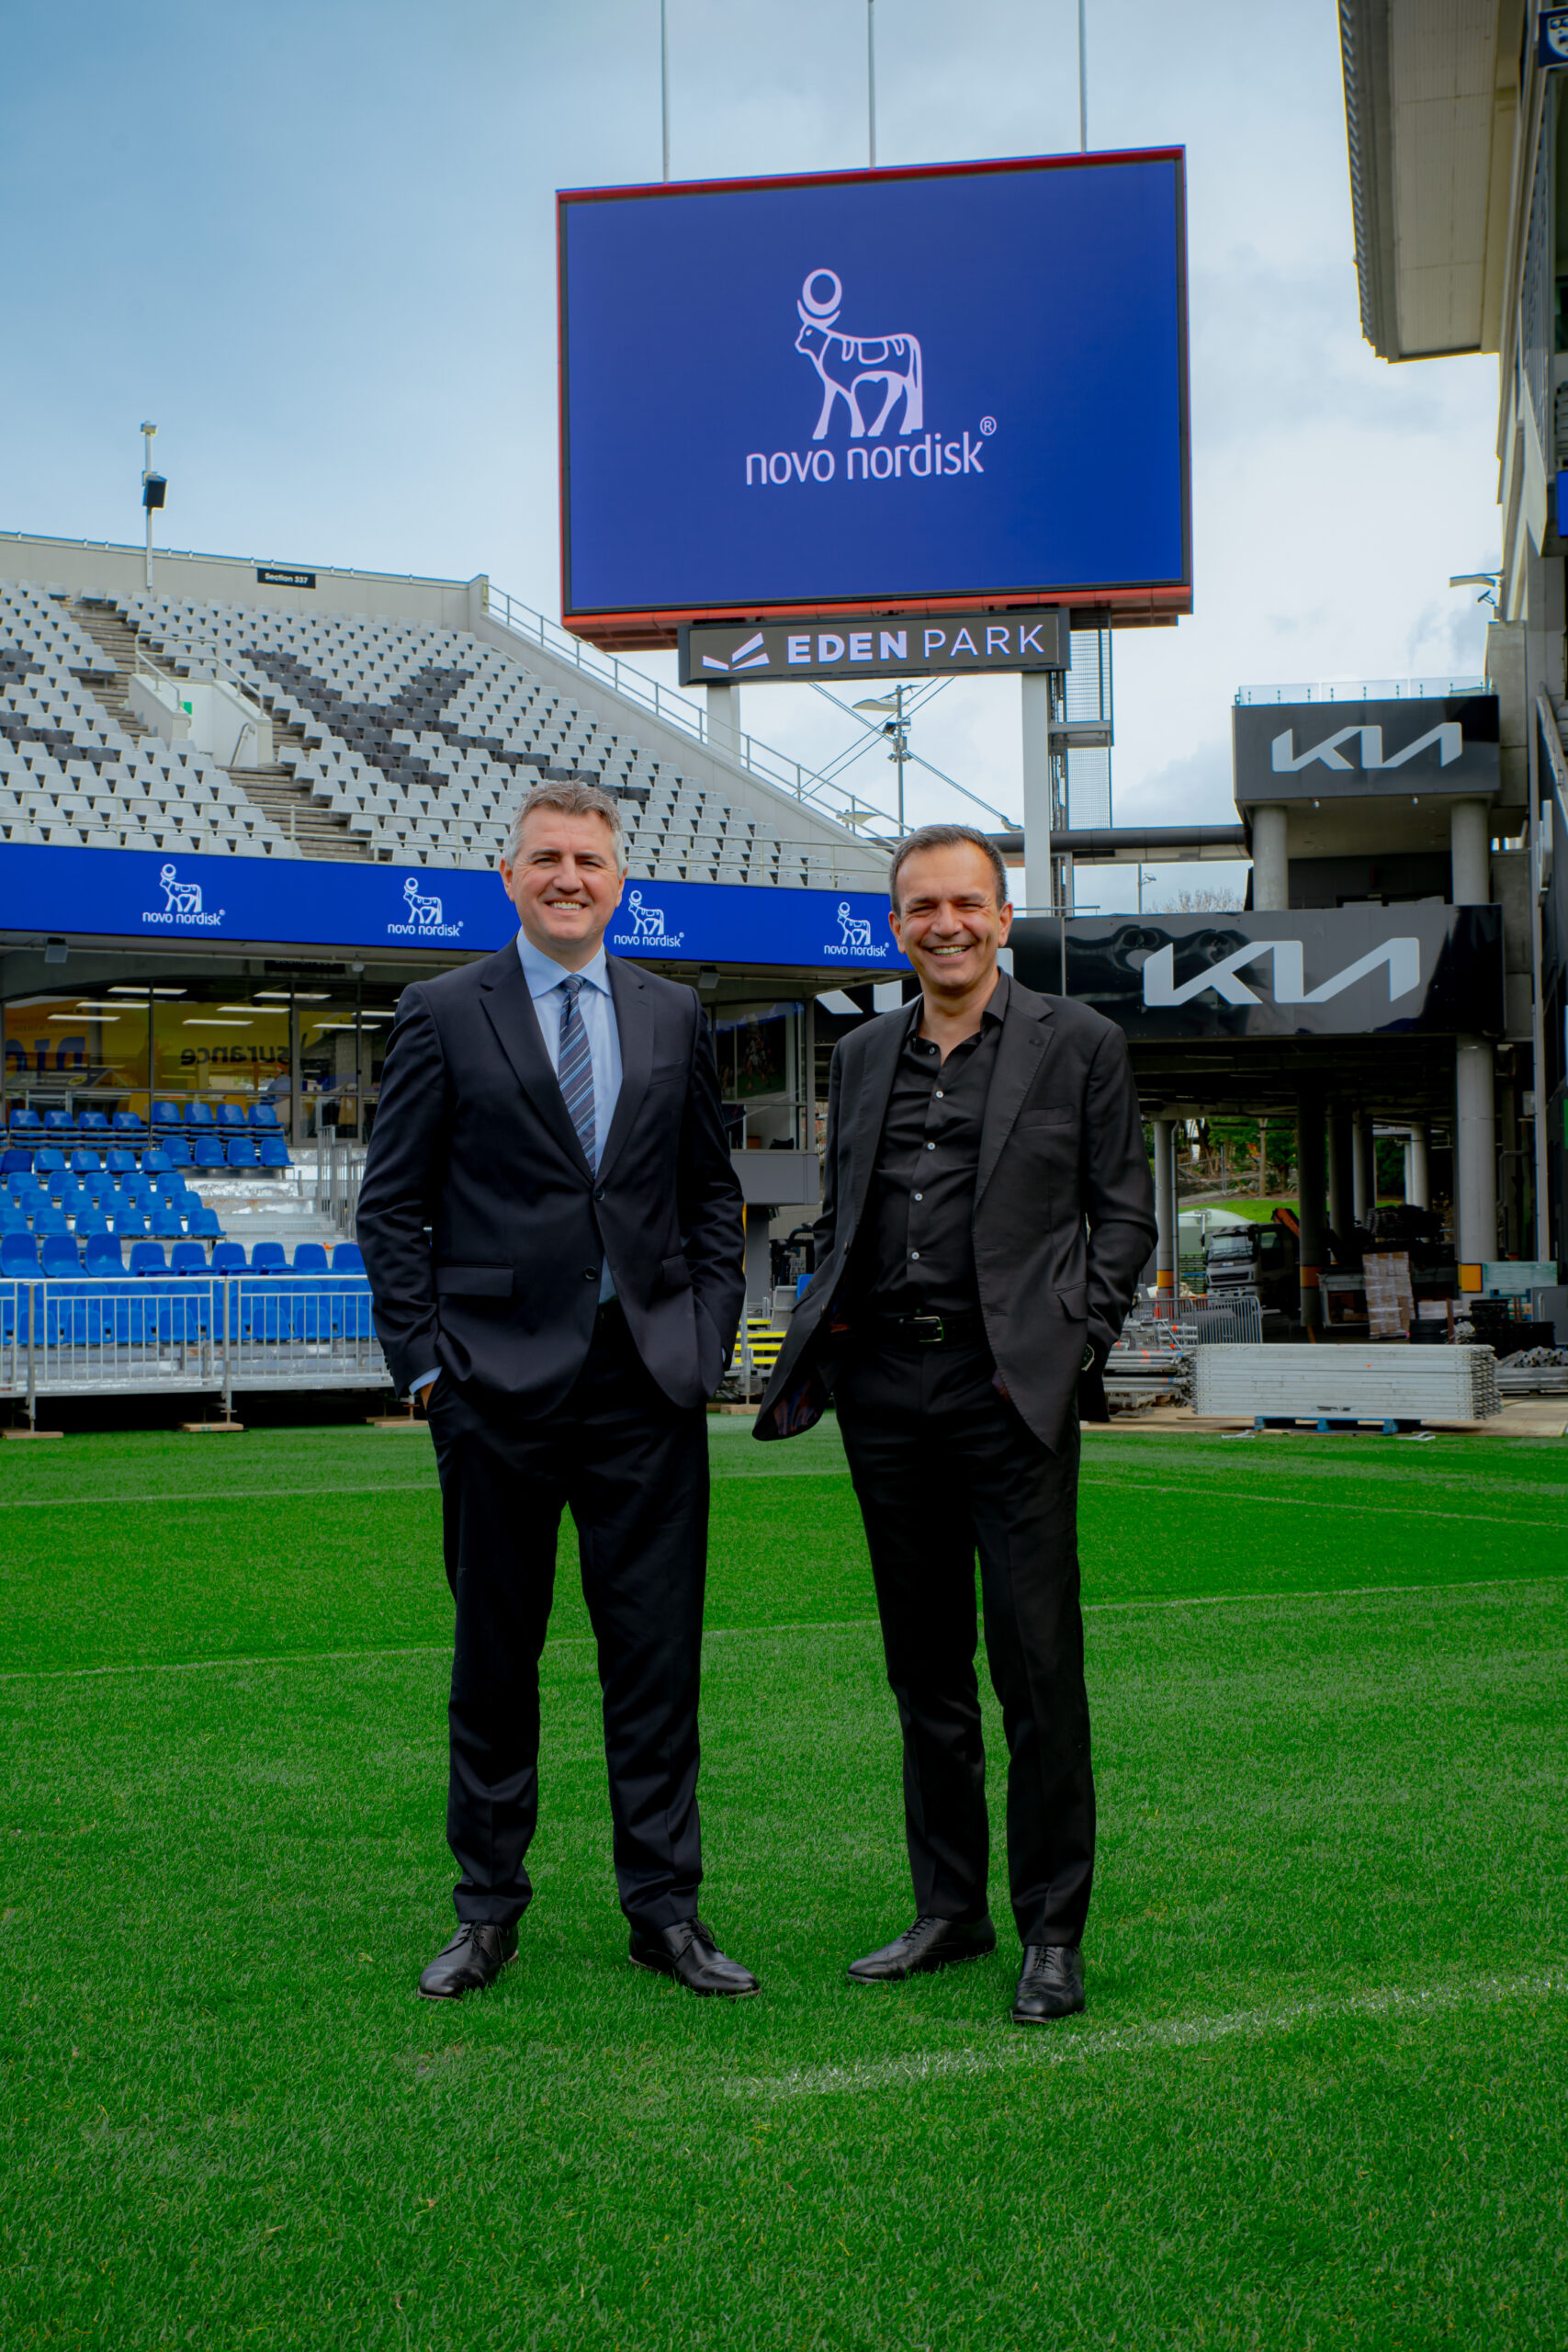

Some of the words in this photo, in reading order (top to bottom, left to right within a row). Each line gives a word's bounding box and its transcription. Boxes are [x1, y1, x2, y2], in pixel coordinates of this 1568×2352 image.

[746, 449, 835, 485] novo
[787, 630, 908, 663] EDEN
[924, 624, 1045, 657] PARK
[142, 911, 174, 923] novo
[388, 923, 416, 934] novo
[614, 934, 640, 944] novo
[824, 944, 849, 955] novo
